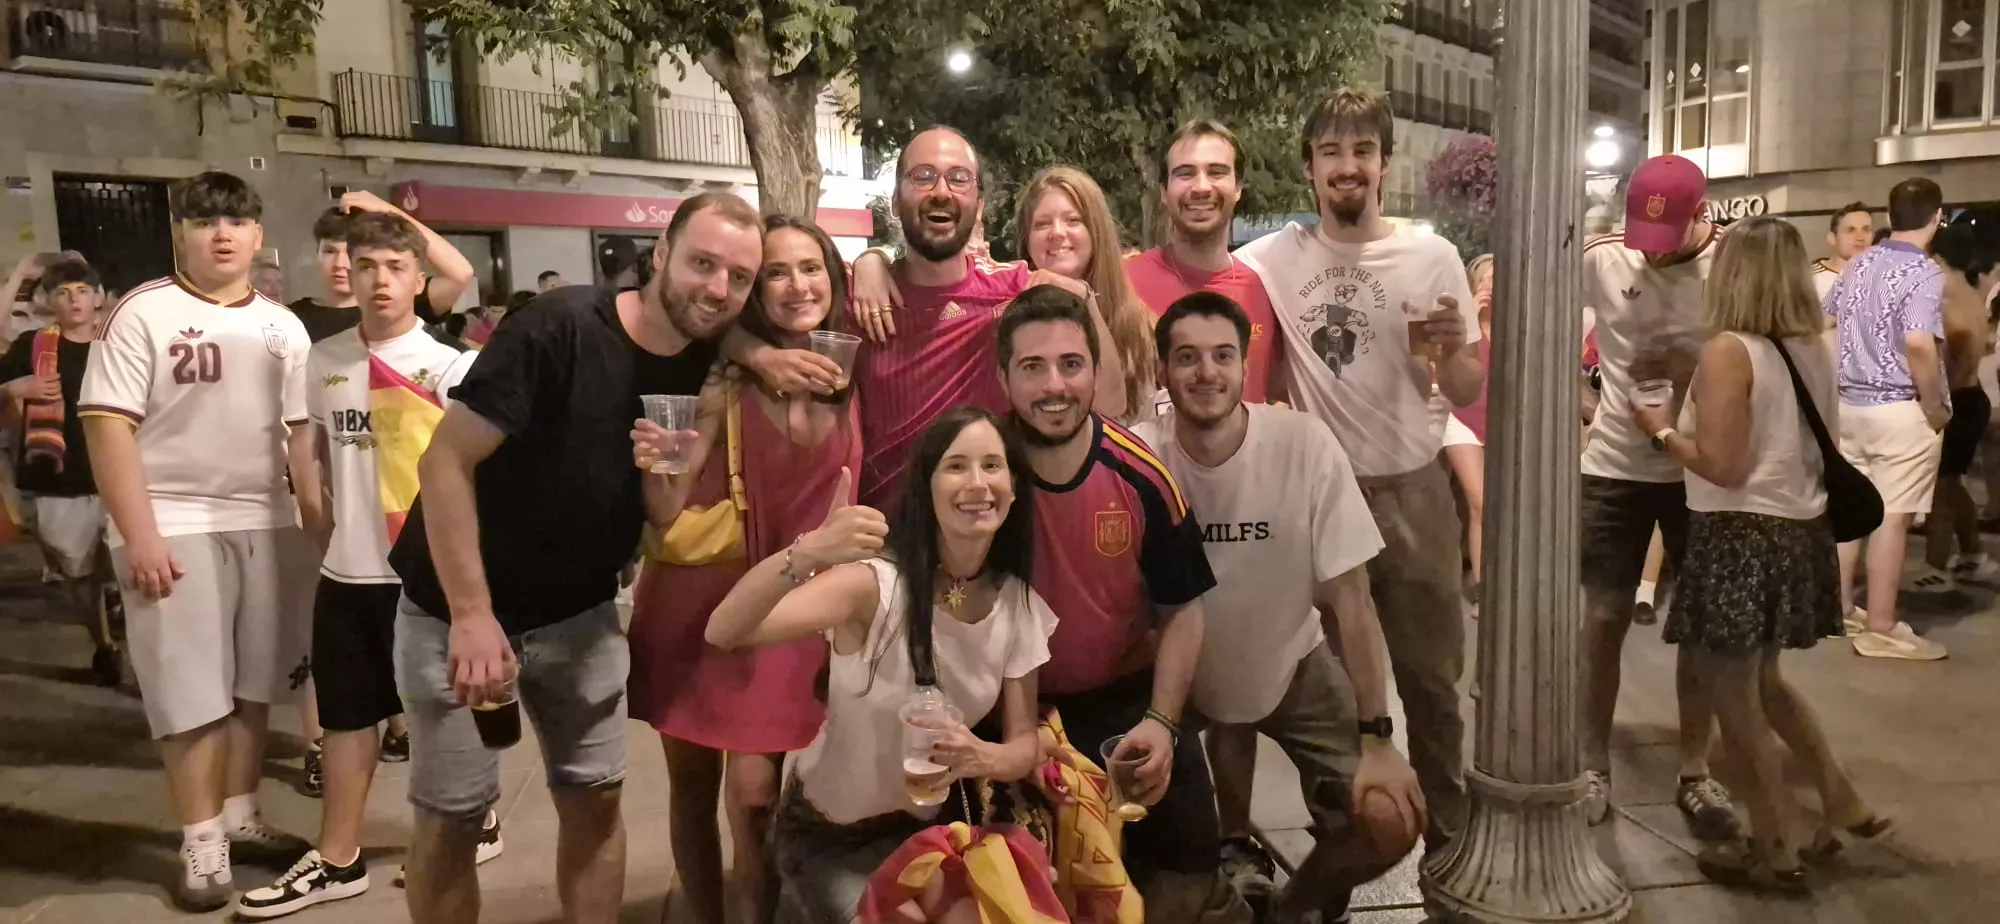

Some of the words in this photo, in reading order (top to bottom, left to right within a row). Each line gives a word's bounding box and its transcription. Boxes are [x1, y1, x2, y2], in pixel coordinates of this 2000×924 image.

[1702, 196, 1766, 221] ANGO
[1299, 275, 1323, 298] RIDE
[1325, 267, 1345, 280] FOR
[1349, 268, 1372, 283] THE
[1369, 281, 1386, 310] NAVY
[169, 342, 222, 384] 20
